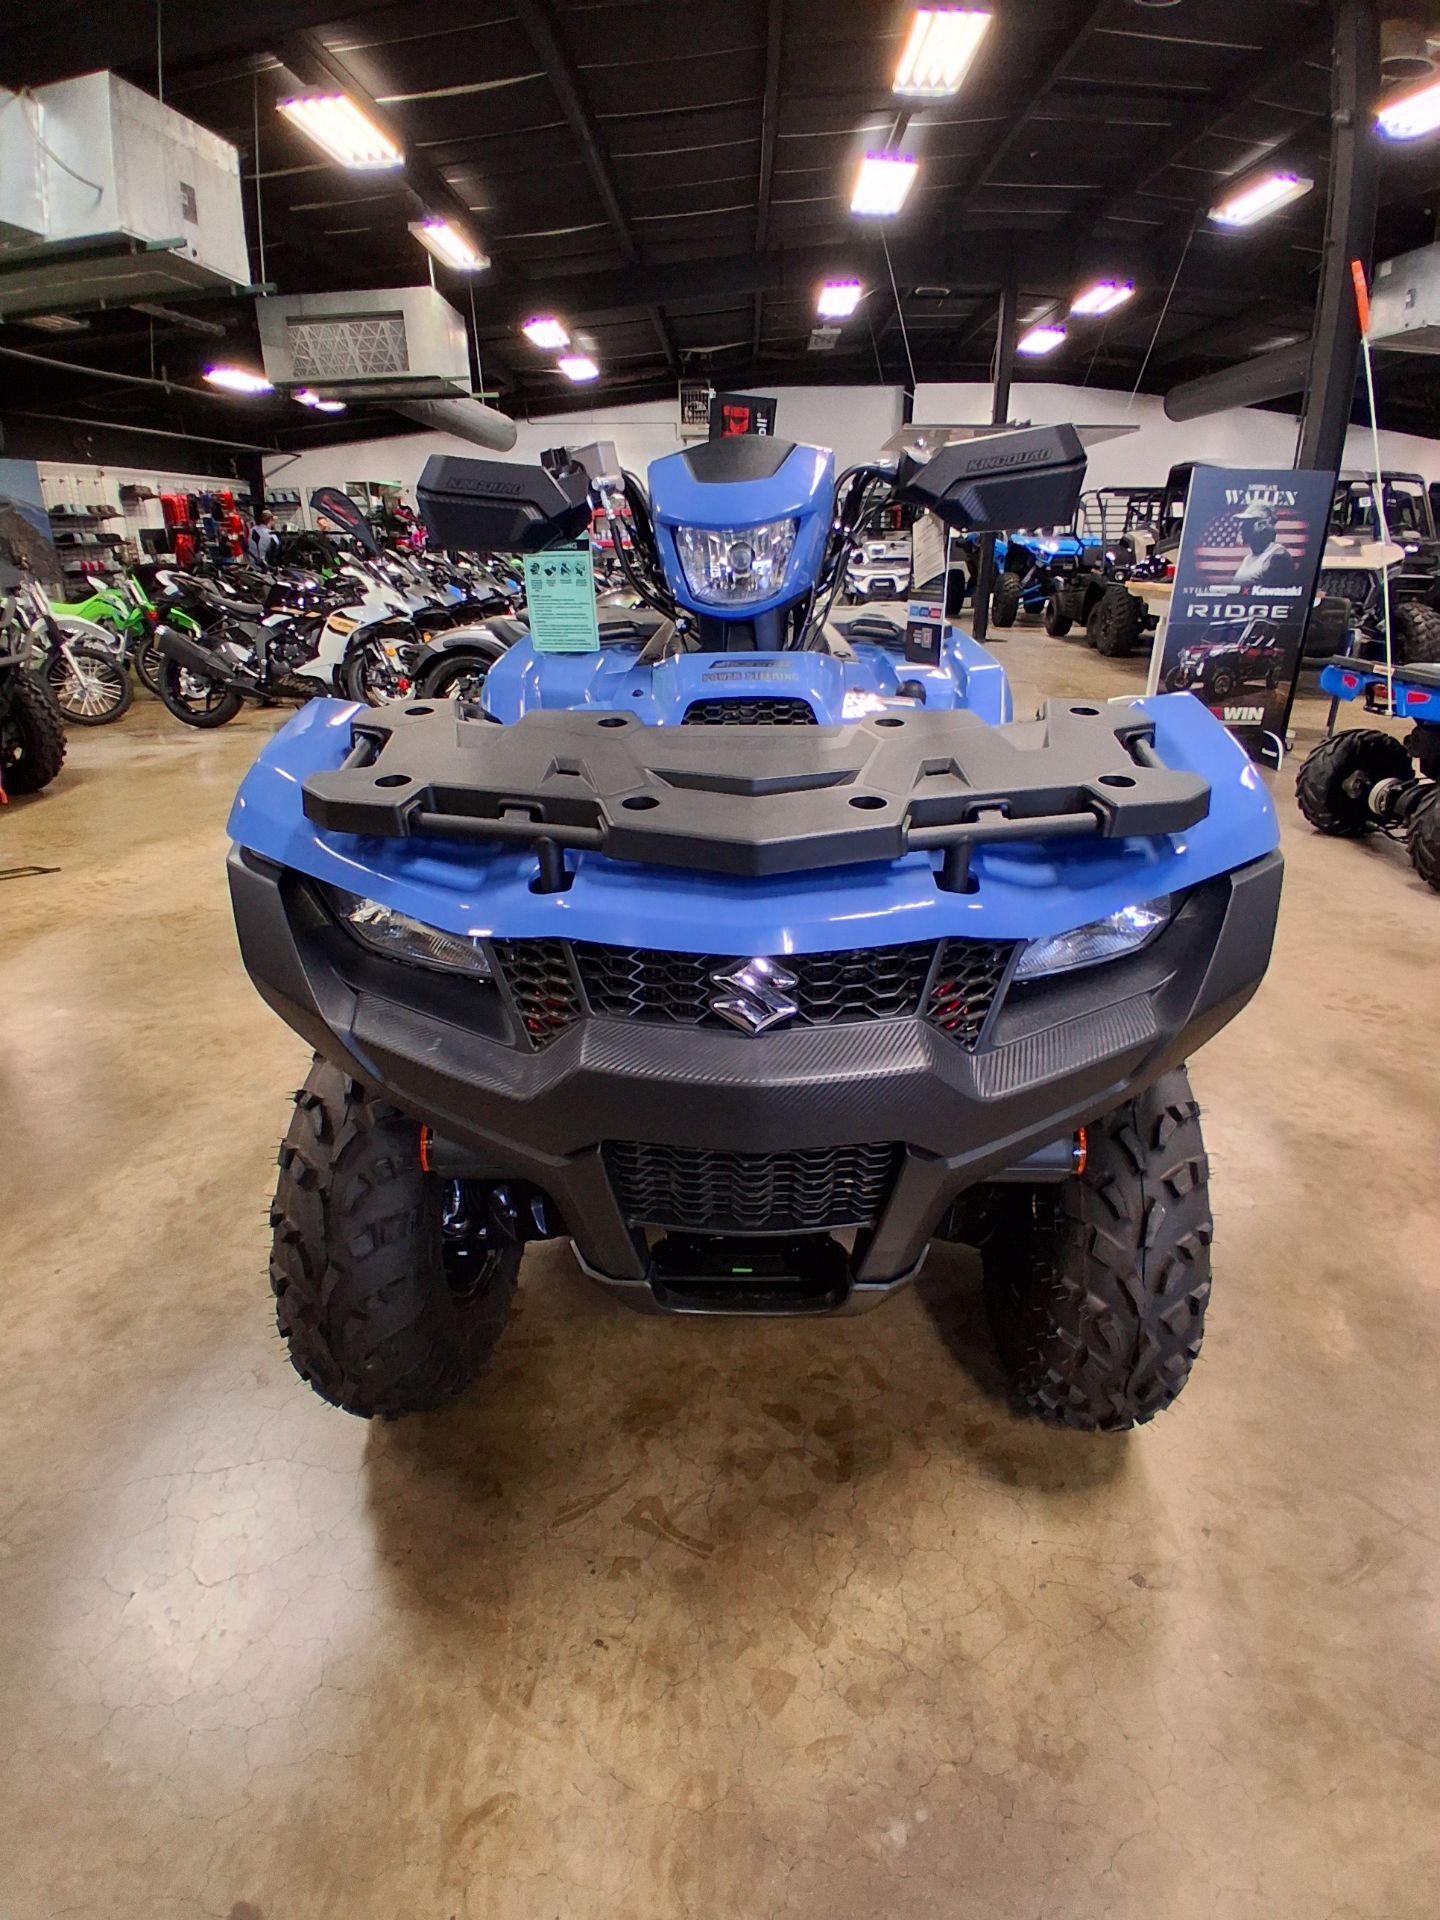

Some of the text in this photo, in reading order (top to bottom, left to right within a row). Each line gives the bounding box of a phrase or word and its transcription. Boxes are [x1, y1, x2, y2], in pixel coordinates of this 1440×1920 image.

[1225, 489, 1298, 506] WALLEN
[1251, 585, 1303, 597] Kawasaki
[1187, 604, 1290, 619] RIDGE
[1223, 707, 1265, 720] WIN
